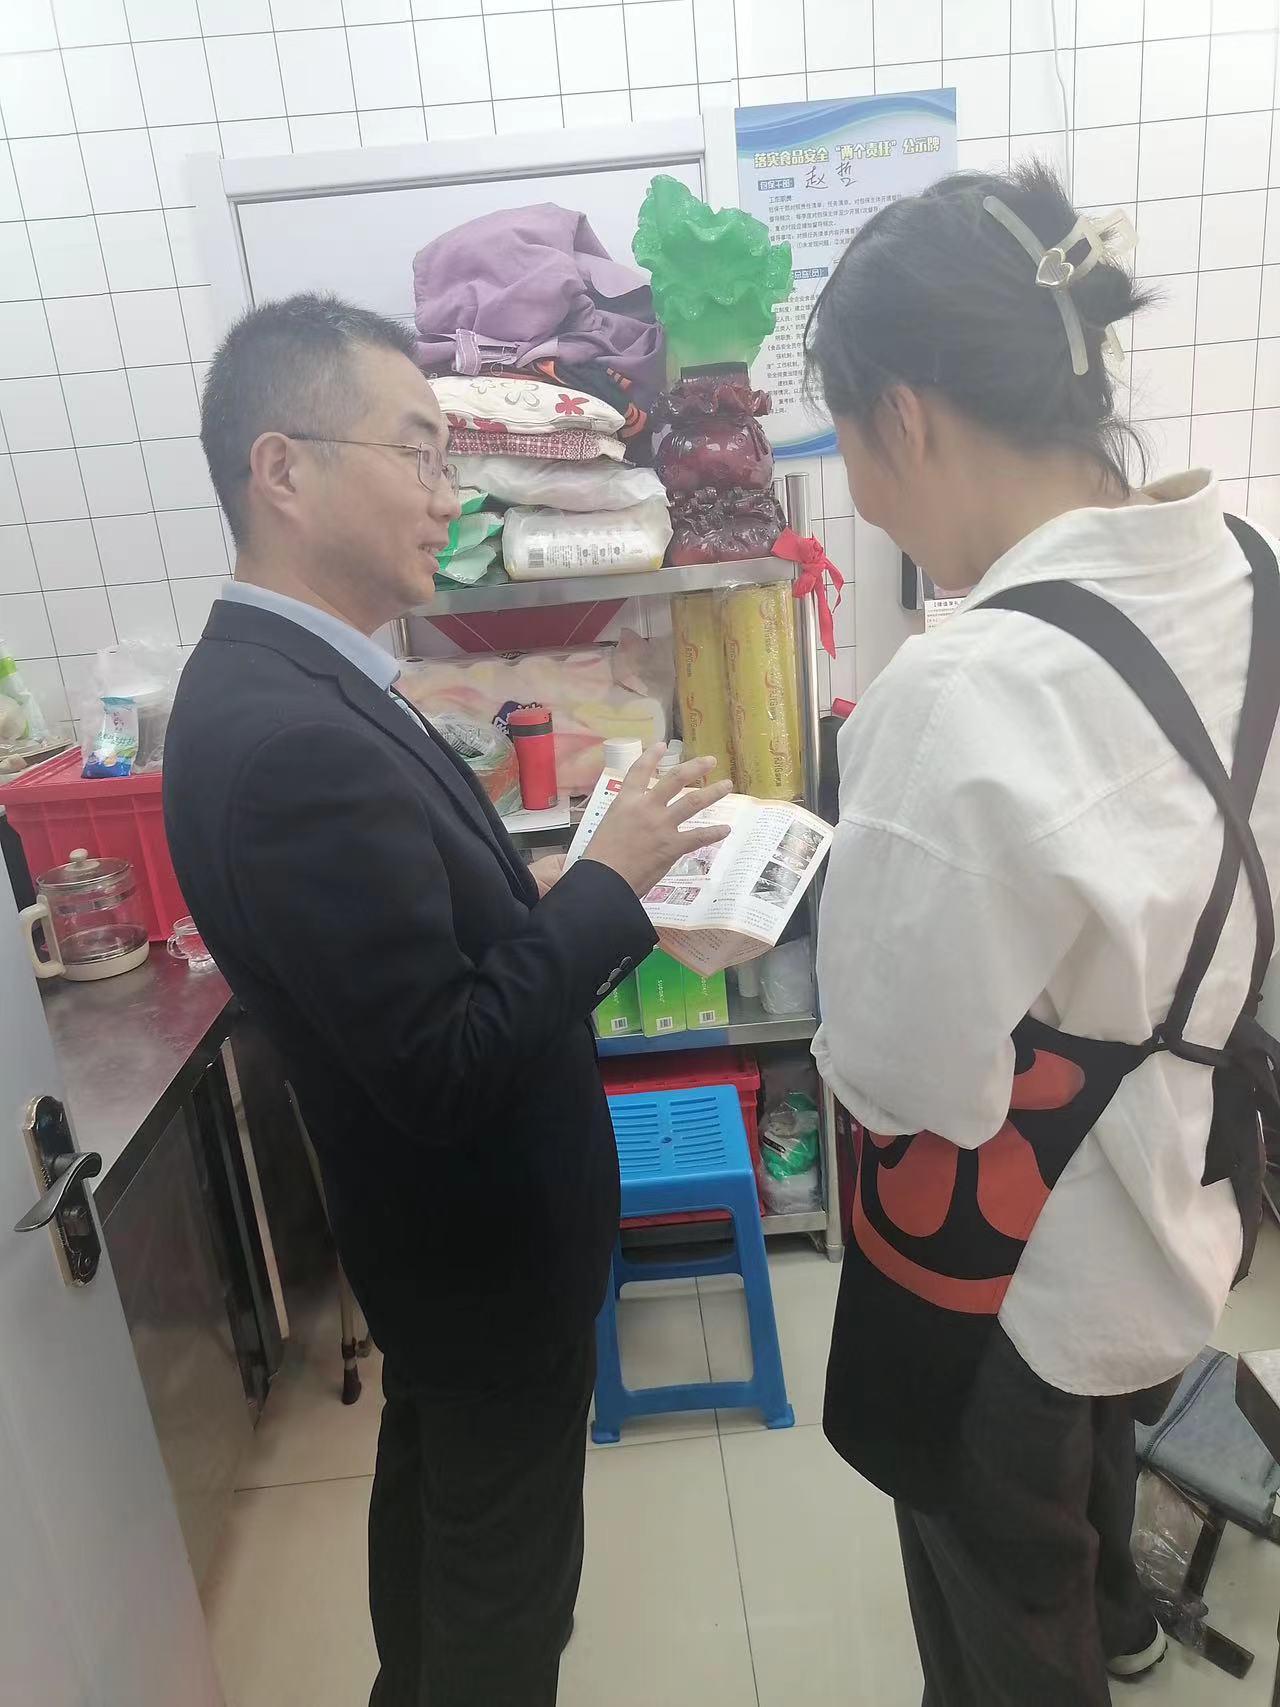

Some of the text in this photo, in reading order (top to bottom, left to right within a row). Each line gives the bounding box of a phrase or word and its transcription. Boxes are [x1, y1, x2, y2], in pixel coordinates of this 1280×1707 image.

[754, 149, 830, 169] 落实食品安全
[903, 136, 941, 154] 公示牌
